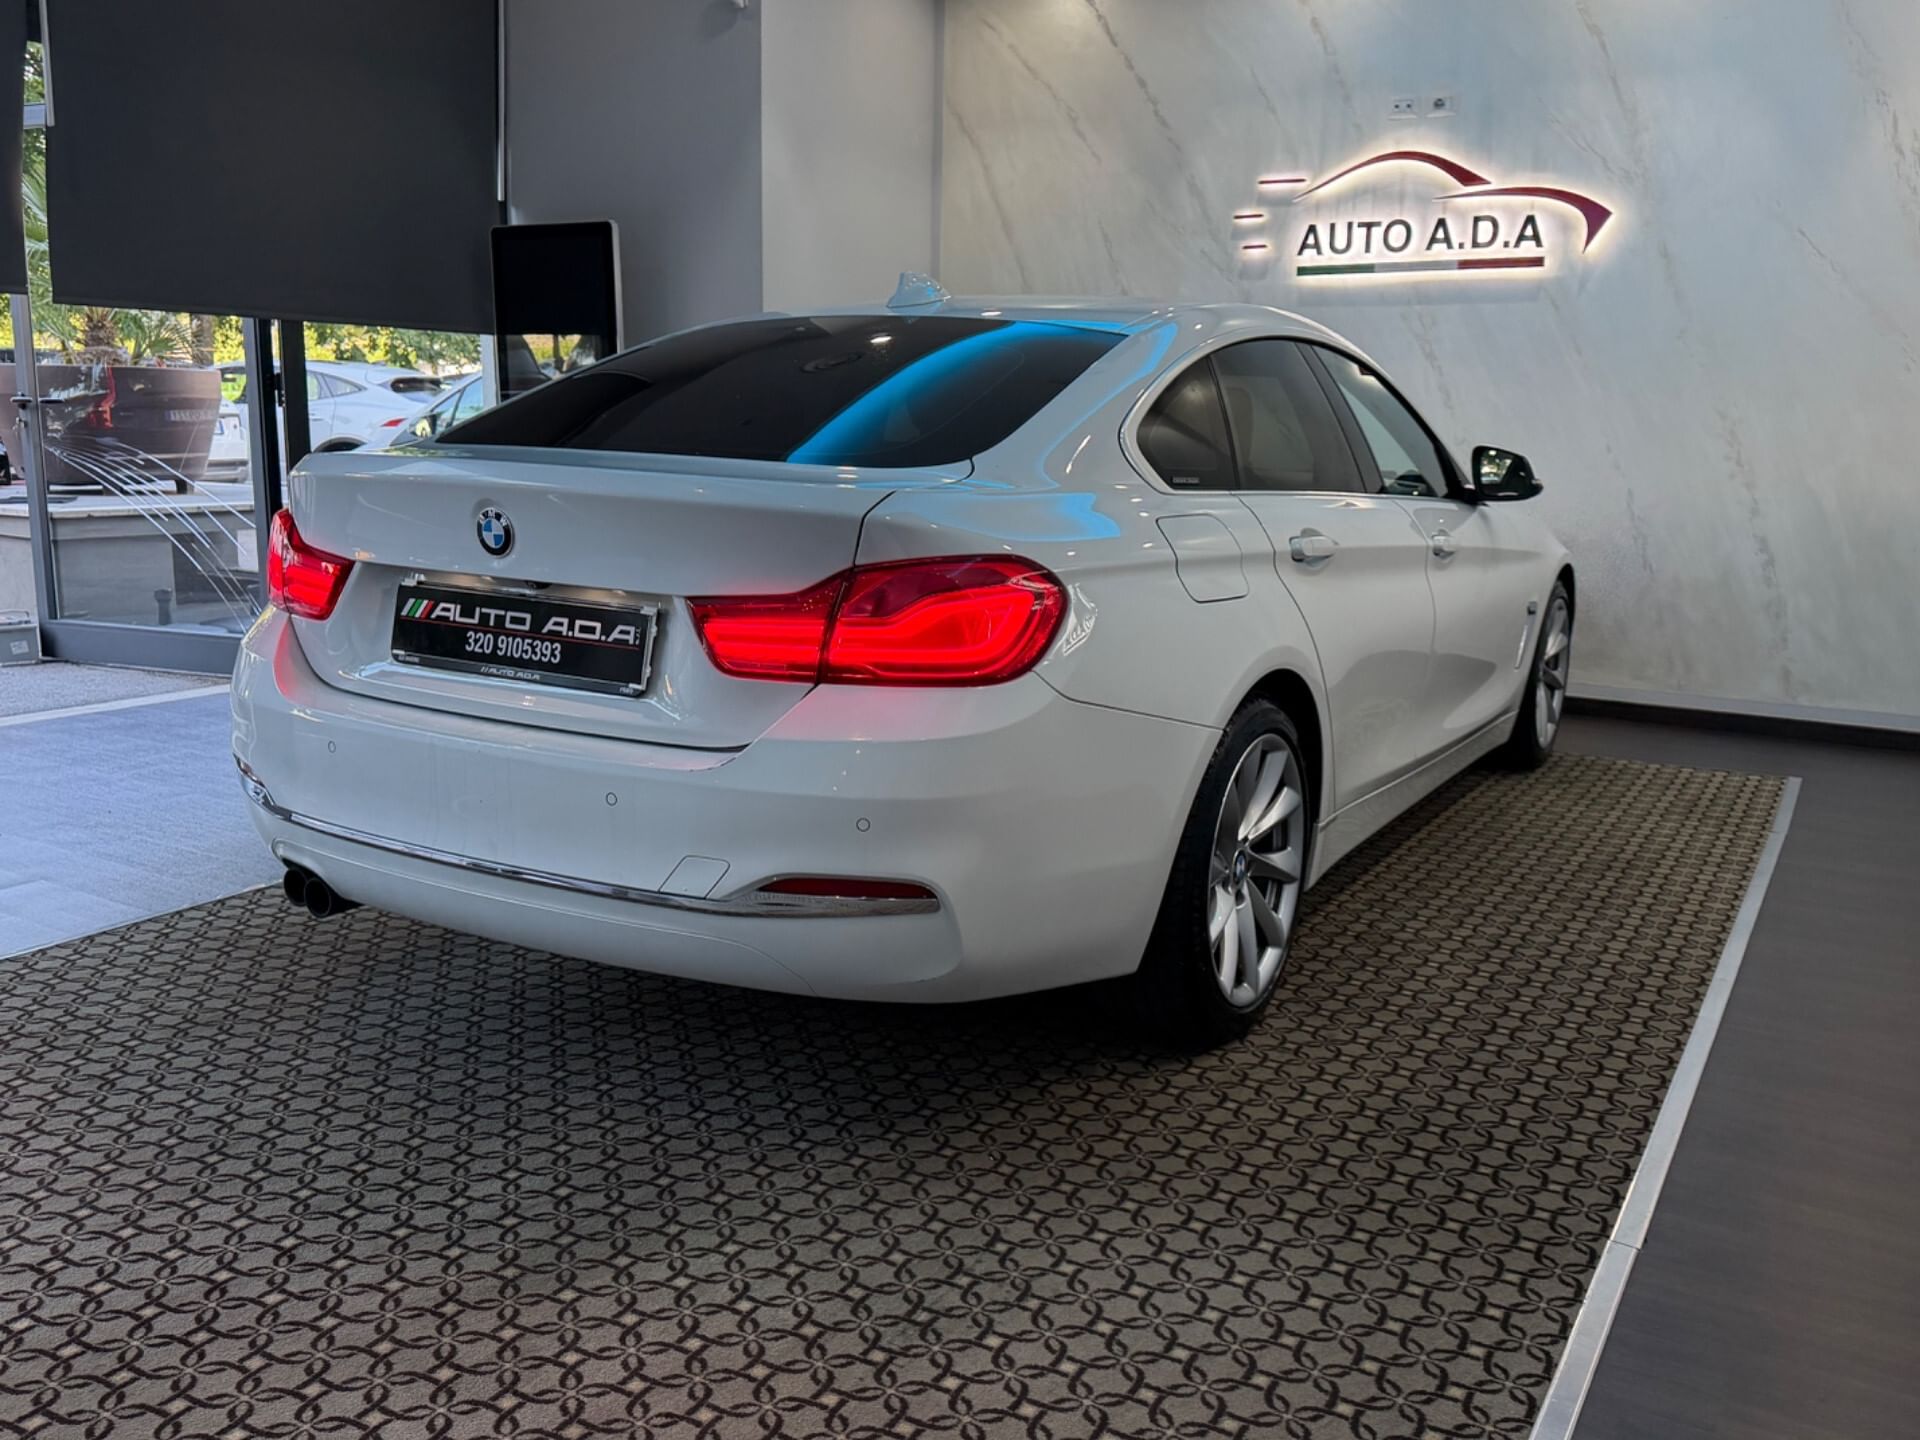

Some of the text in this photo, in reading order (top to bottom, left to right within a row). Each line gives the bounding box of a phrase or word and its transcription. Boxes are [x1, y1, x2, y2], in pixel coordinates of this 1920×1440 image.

[1297, 214, 1545, 257] AUTO A.D.A
[478, 508, 508, 527] BMW
[431, 602, 531, 631] AUTO
[465, 631, 562, 664] 320 9105393
[487, 667, 515, 678] AUTO
